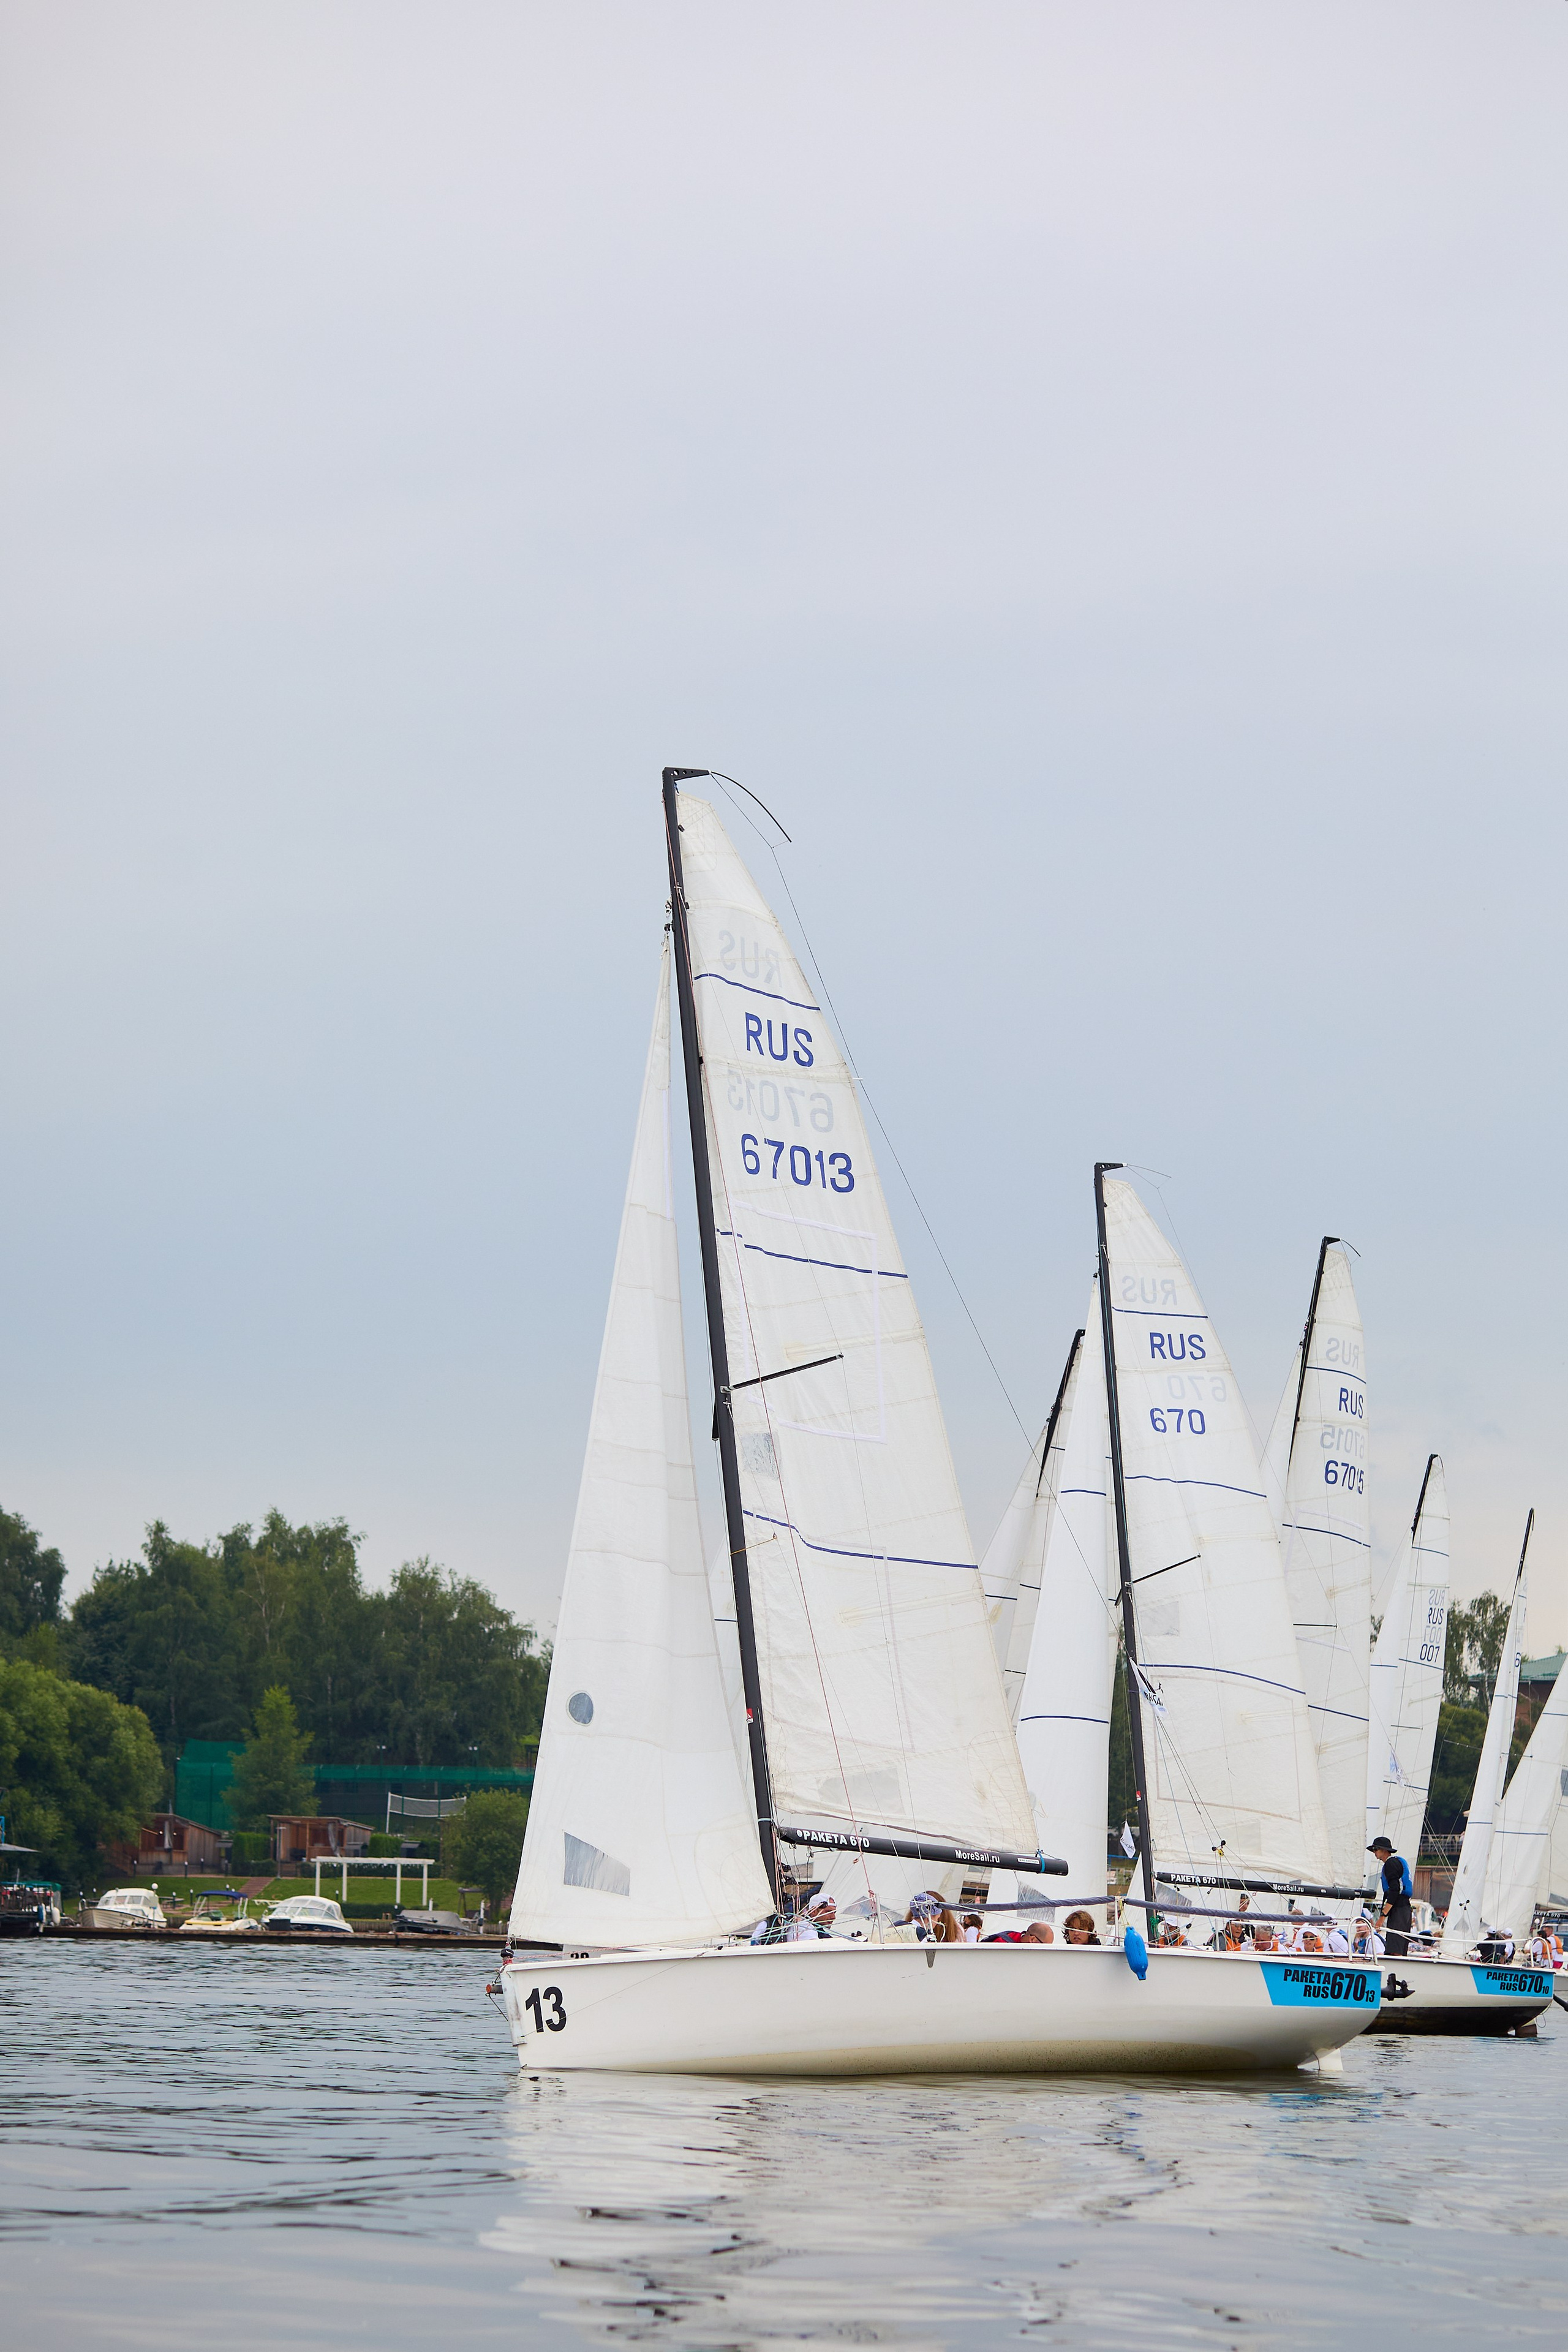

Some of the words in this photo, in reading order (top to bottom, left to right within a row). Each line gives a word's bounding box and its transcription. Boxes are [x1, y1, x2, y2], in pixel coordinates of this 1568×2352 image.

[745, 1012, 815, 1068] RUS
[741, 1133, 854, 1193] 67013
[1149, 1332, 1207, 1360] RUS
[1338, 1387, 1363, 1419] RUS
[1150, 1408, 1206, 1434] 670
[1324, 1460, 1364, 1494] 67015
[1428, 1607, 1444, 1624] RUS
[1420, 1644, 1440, 1662] 007
[850, 1836, 870, 1848] 670
[954, 1849, 1000, 1863] MoreSail.ru
[1273, 1883, 1305, 1893] MoreSail.ru
[1303, 1985, 1330, 1999] RUS
[1330, 1972, 1366, 2001] 670
[1365, 1990, 1375, 2002] 13
[1499, 1982, 1518, 1991] RUS
[1518, 1973, 1544, 1993] 670
[1542, 1986, 1550, 1994] 10
[524, 1986, 567, 2034] 13
